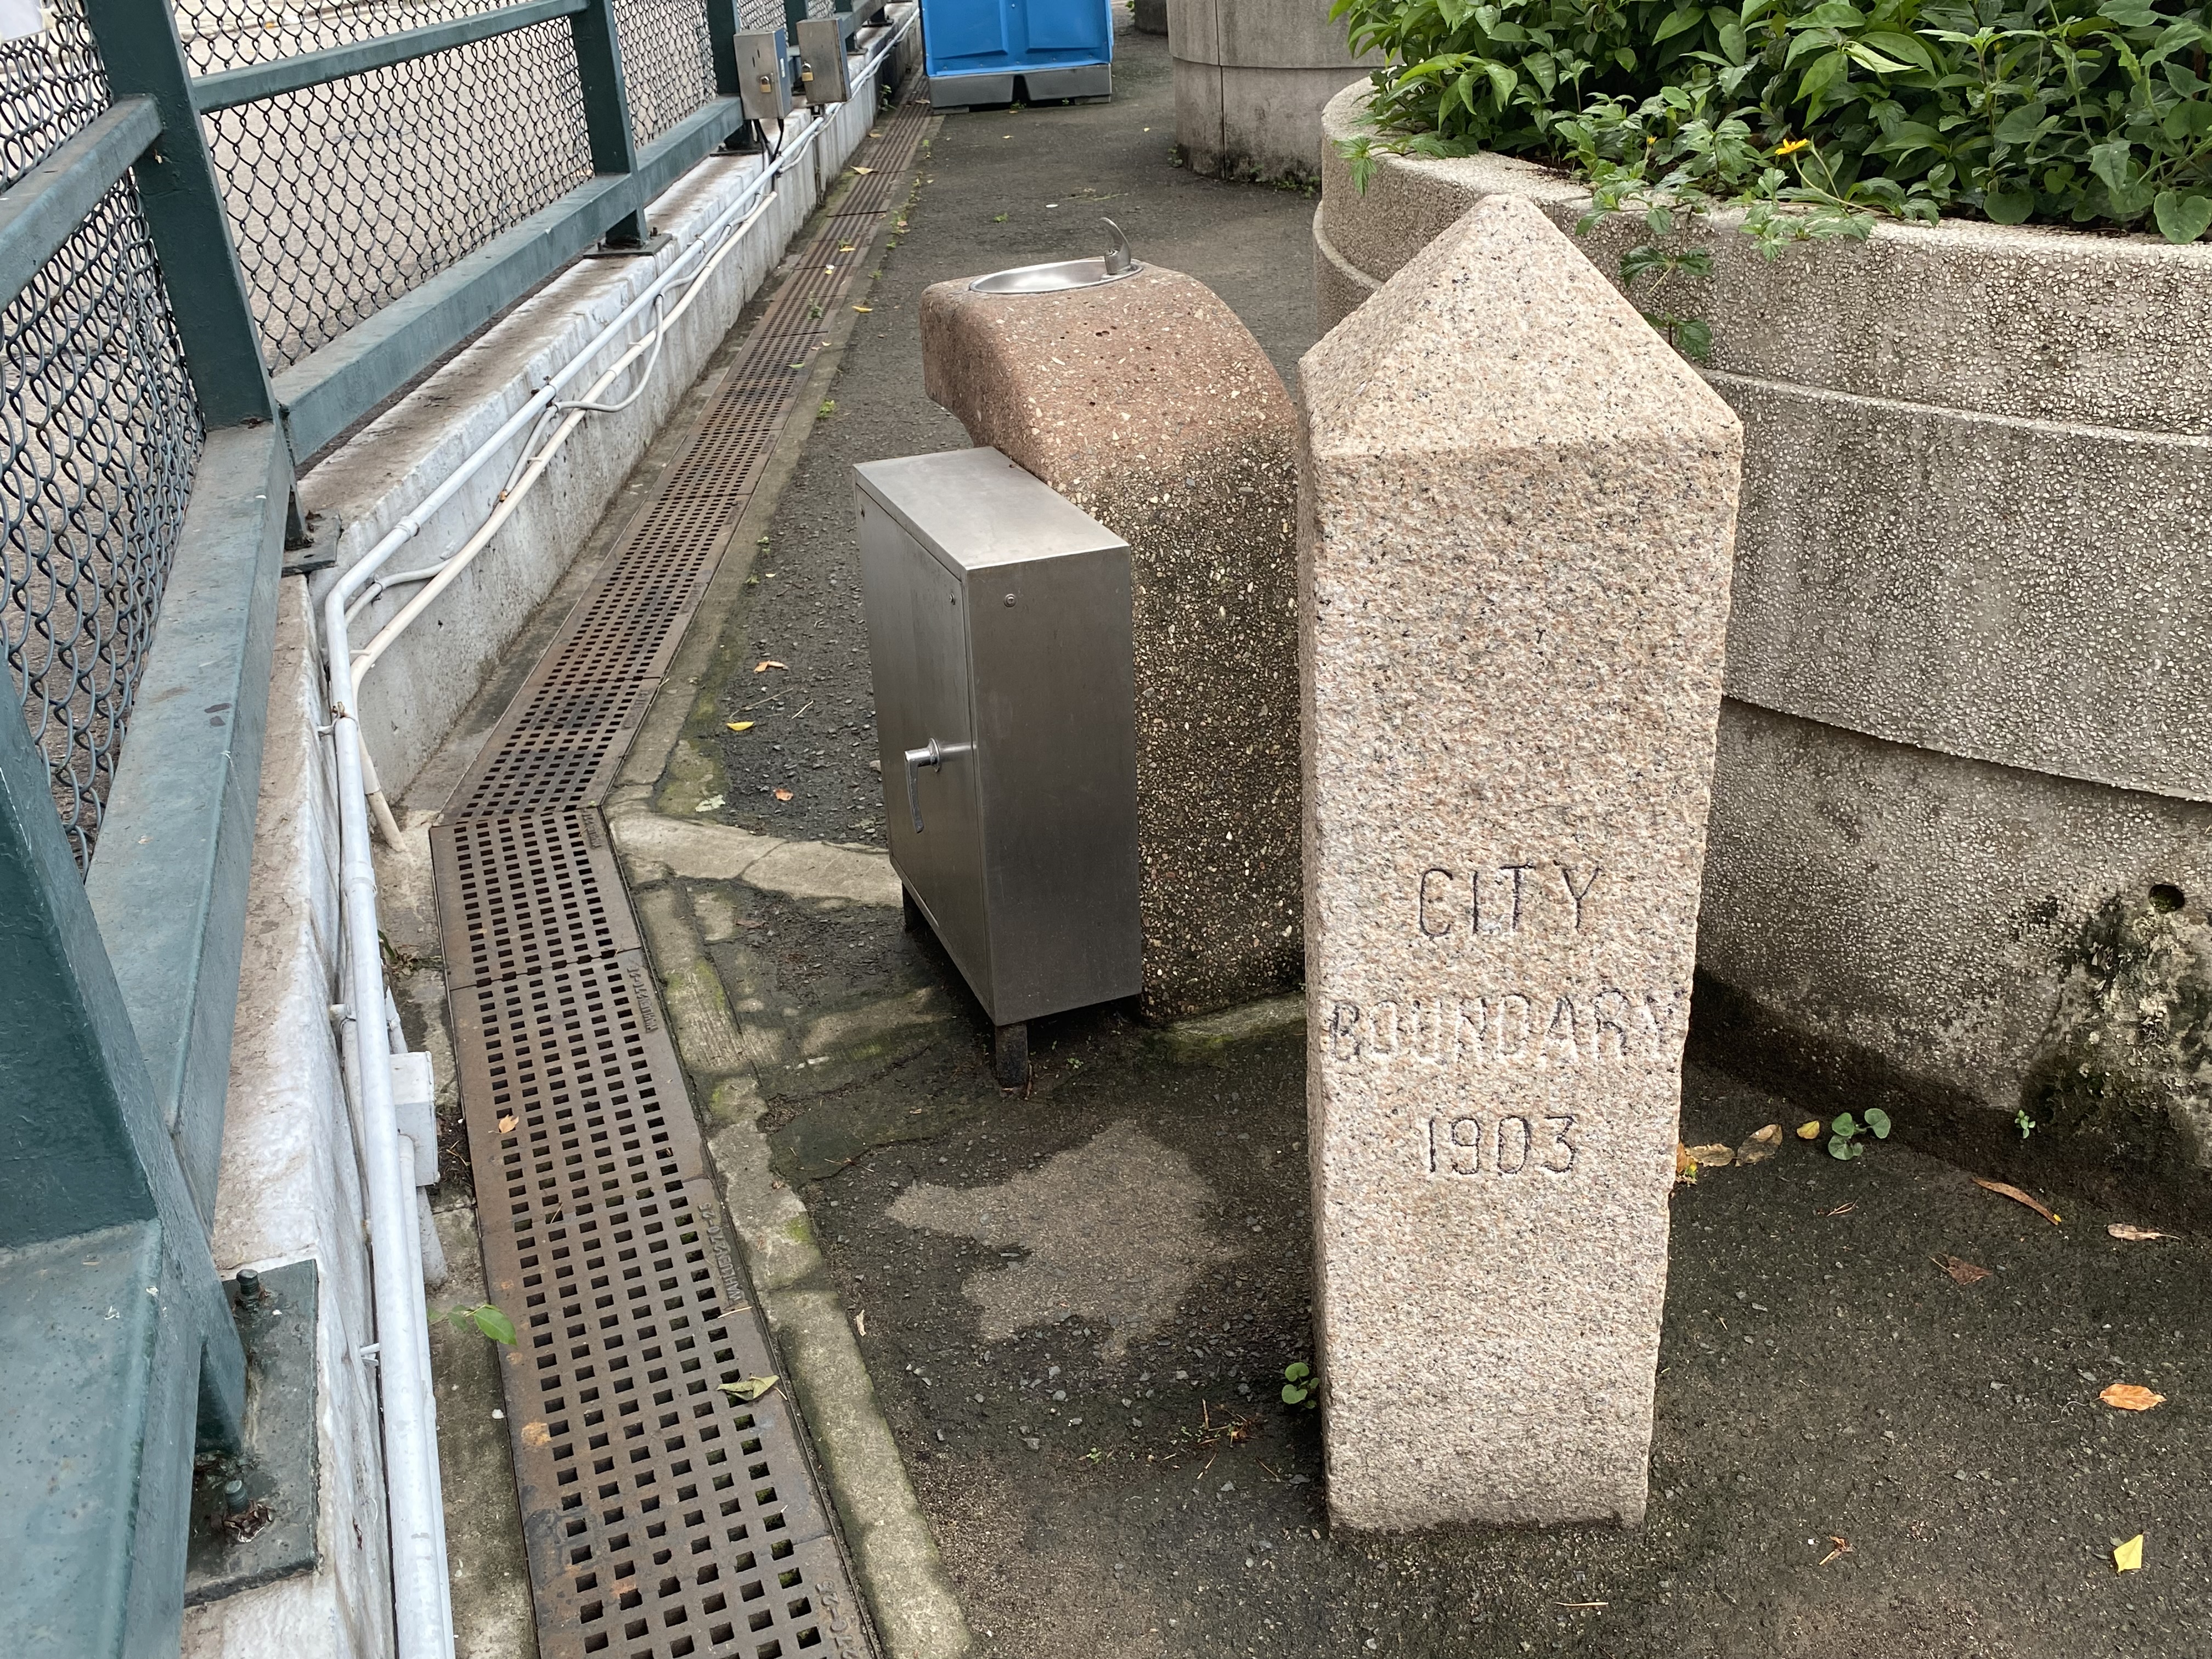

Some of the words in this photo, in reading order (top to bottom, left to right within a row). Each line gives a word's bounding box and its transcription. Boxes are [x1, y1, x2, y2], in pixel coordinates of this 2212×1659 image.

[1419, 863, 1602, 938] CITY
[1328, 988, 1688, 1061] BOUNDARY
[1427, 1114, 1578, 1176] 1903
